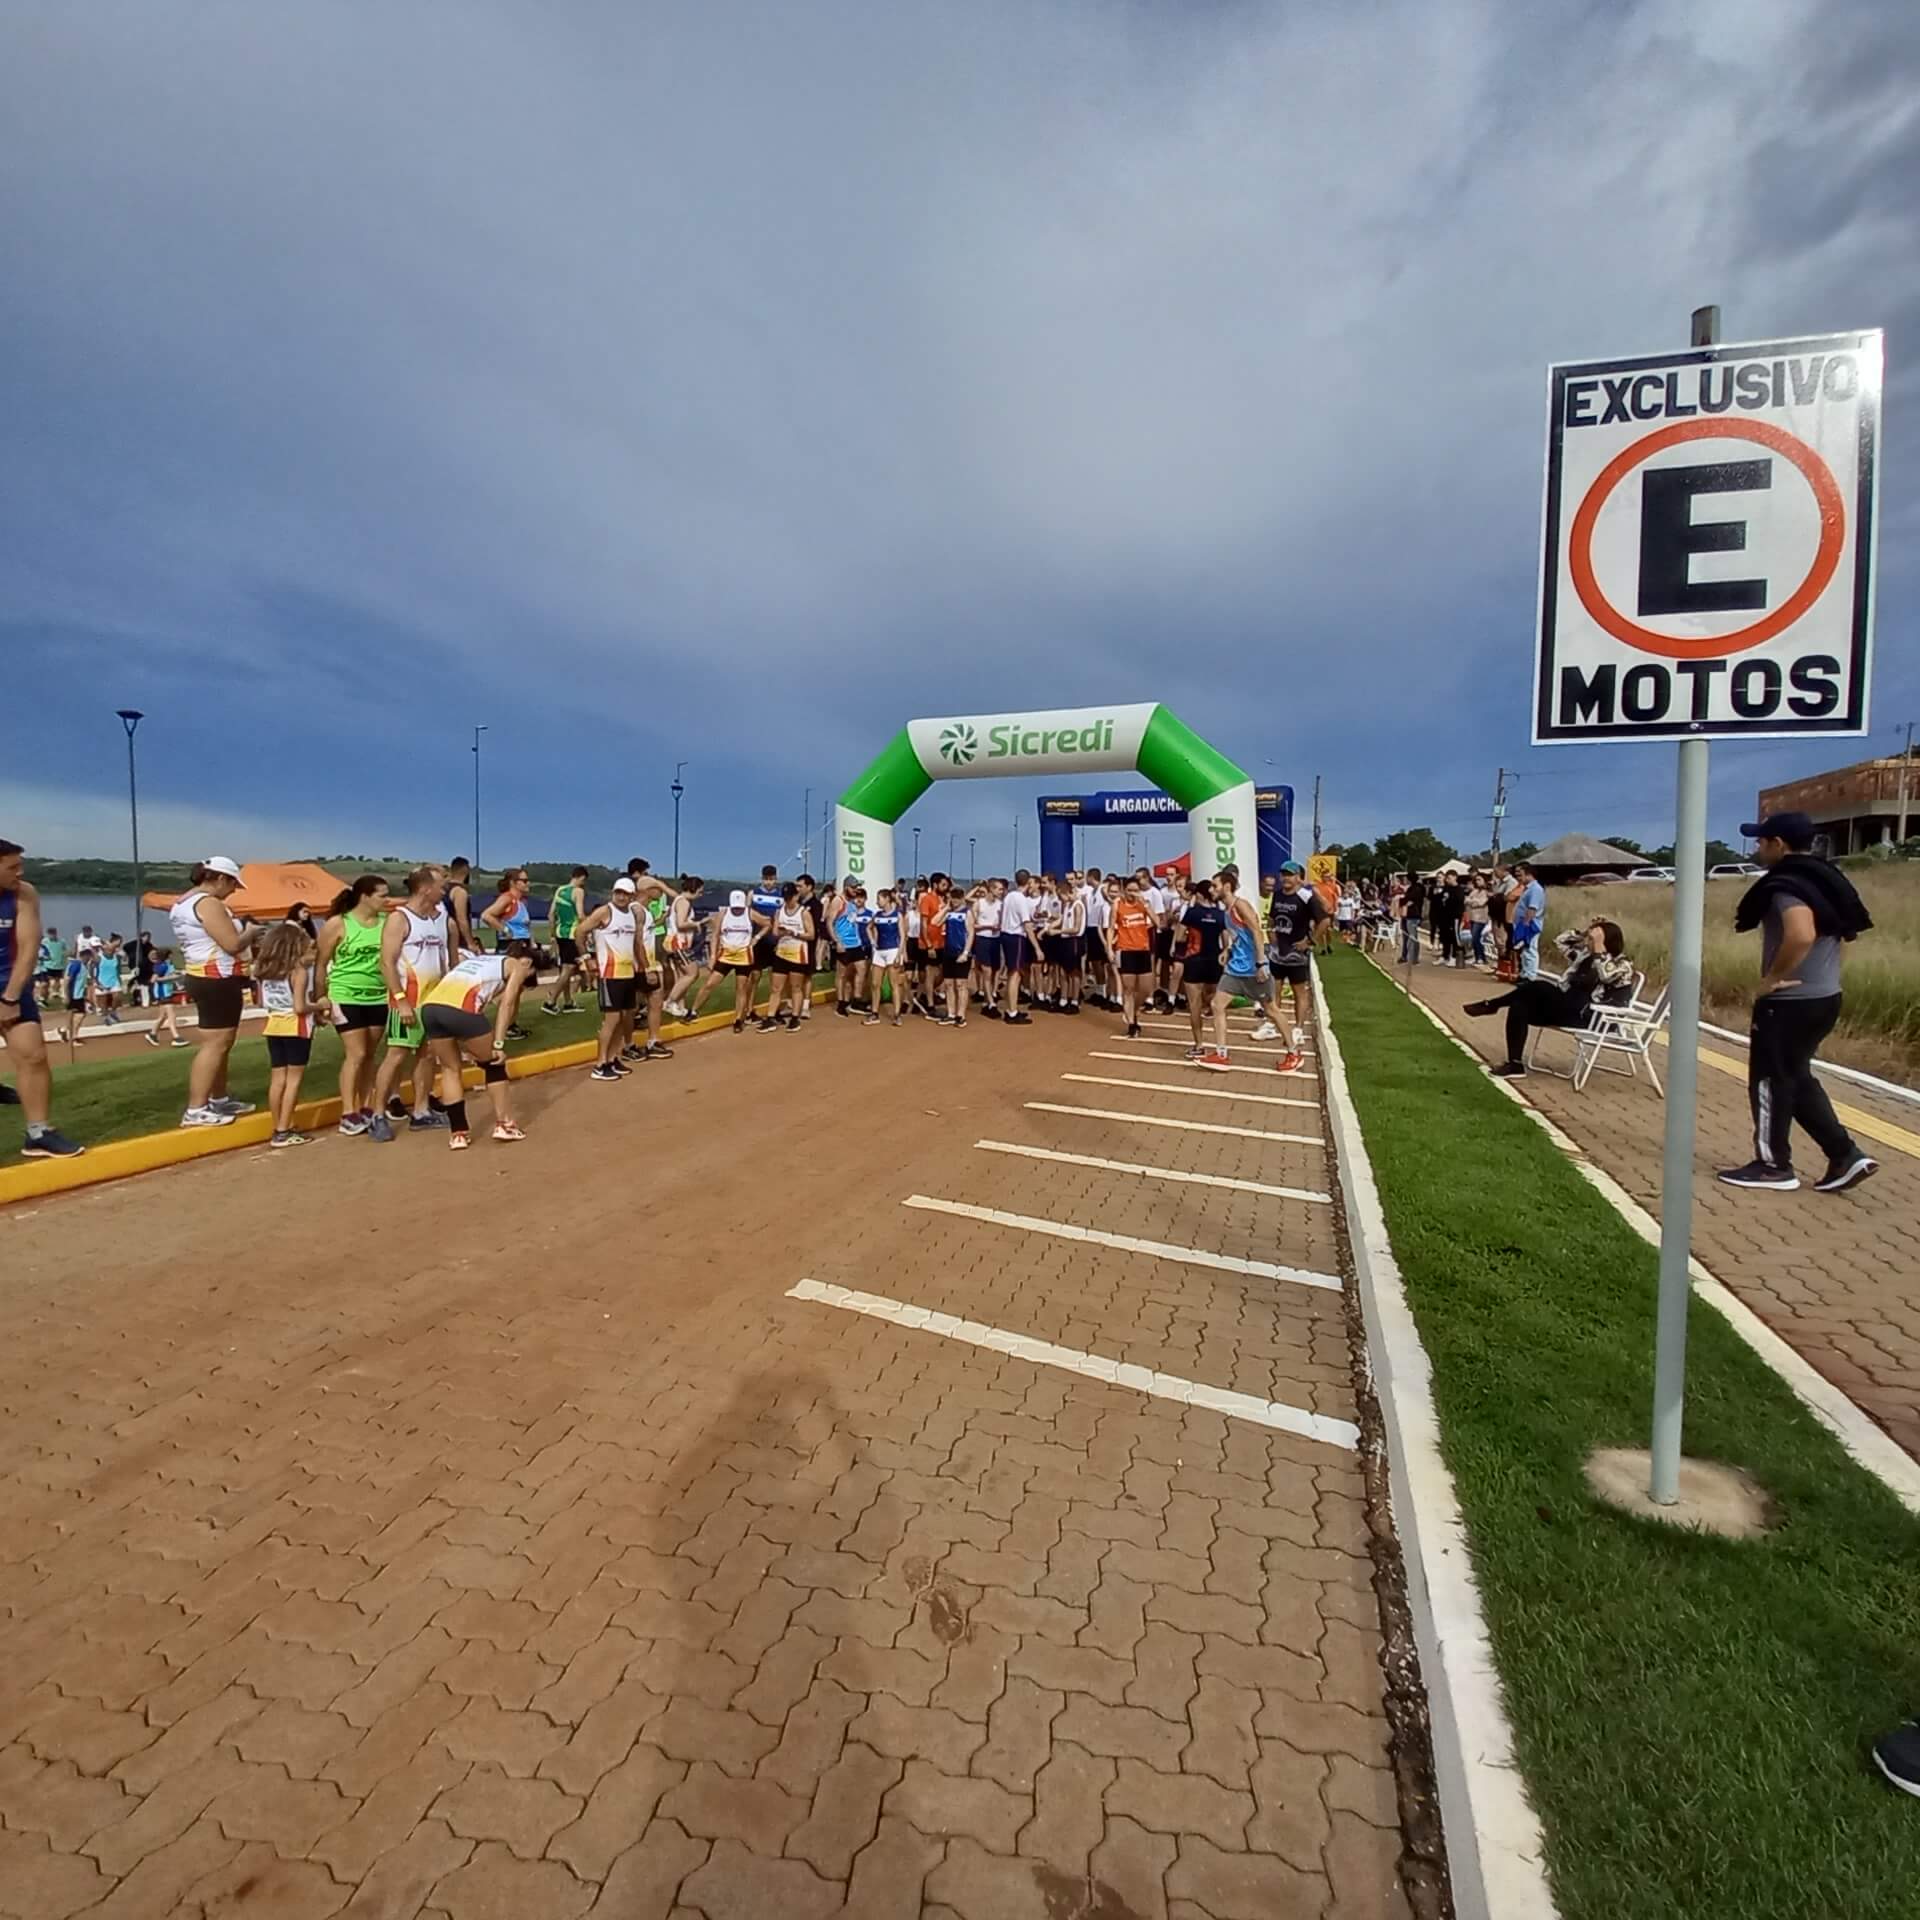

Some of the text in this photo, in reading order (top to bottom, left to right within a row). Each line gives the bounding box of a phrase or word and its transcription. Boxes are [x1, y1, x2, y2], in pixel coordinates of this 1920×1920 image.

[1565, 353, 1859, 428] EXCLUSIVO
[1637, 457, 1772, 617] E
[1559, 654, 1842, 725] MOTOS
[987, 719, 1114, 758] Sicredi
[1207, 817, 1236, 869] edi
